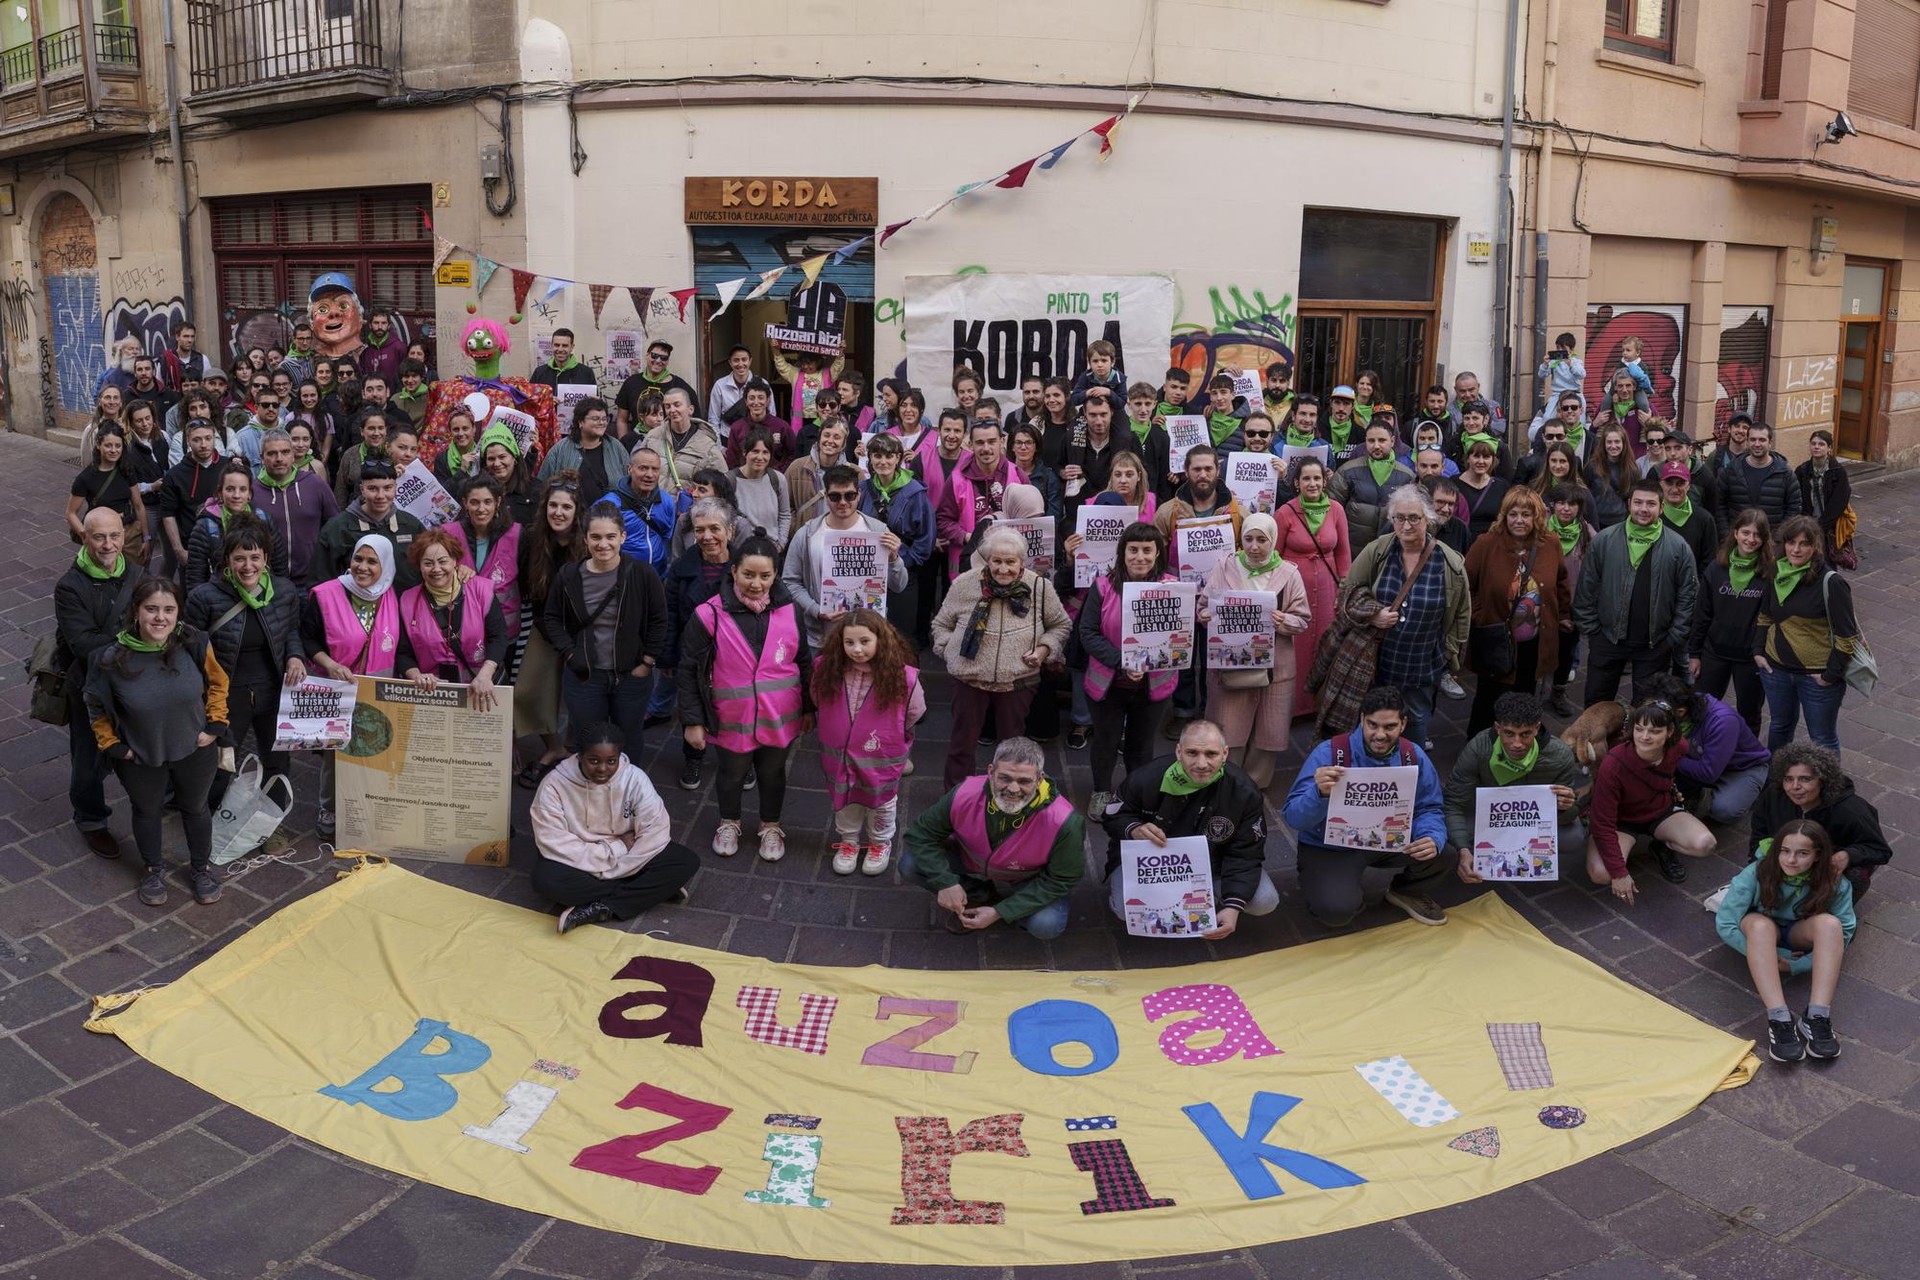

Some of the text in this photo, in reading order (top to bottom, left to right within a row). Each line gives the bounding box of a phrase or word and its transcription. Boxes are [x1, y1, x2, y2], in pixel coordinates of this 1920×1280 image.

[722, 180, 838, 208] KORDA
[1046, 292, 1120, 314] PINTO 51
[1233, 378, 1252, 386] ORDA
[1236, 462, 1267, 471] KORDA
[396, 481, 426, 504] DEFENDA
[1086, 518, 1124, 529] KORDA
[1187, 528, 1222, 539] KORDA
[1188, 538, 1224, 547] DEFENDA
[832, 546, 876, 554] DESALOJO
[832, 568, 876, 576] DESALOJO
[1133, 598, 1181, 609] DESALOJO
[1135, 608, 1179, 617] ARRISKUAN
[1217, 606, 1261, 614] DESALOJO
[1134, 622, 1182, 633] DESALOJO
[1219, 625, 1262, 633] DESALOJO
[302, 684, 332, 692] KORDA
[384, 694, 458, 706] elikadura sarea
[1346, 782, 1398, 792] KORDA
[1345, 792, 1398, 800] DEFENDA
[1490, 801, 1539, 813] KORDA
[1490, 812, 1541, 821] DEFENDA
[1137, 854, 1191, 868] KORDA
[1138, 866, 1193, 877] DEFENDA
[1138, 874, 1189, 884] DEZAGUN!!
[598, 955, 1285, 1076] auzoa
